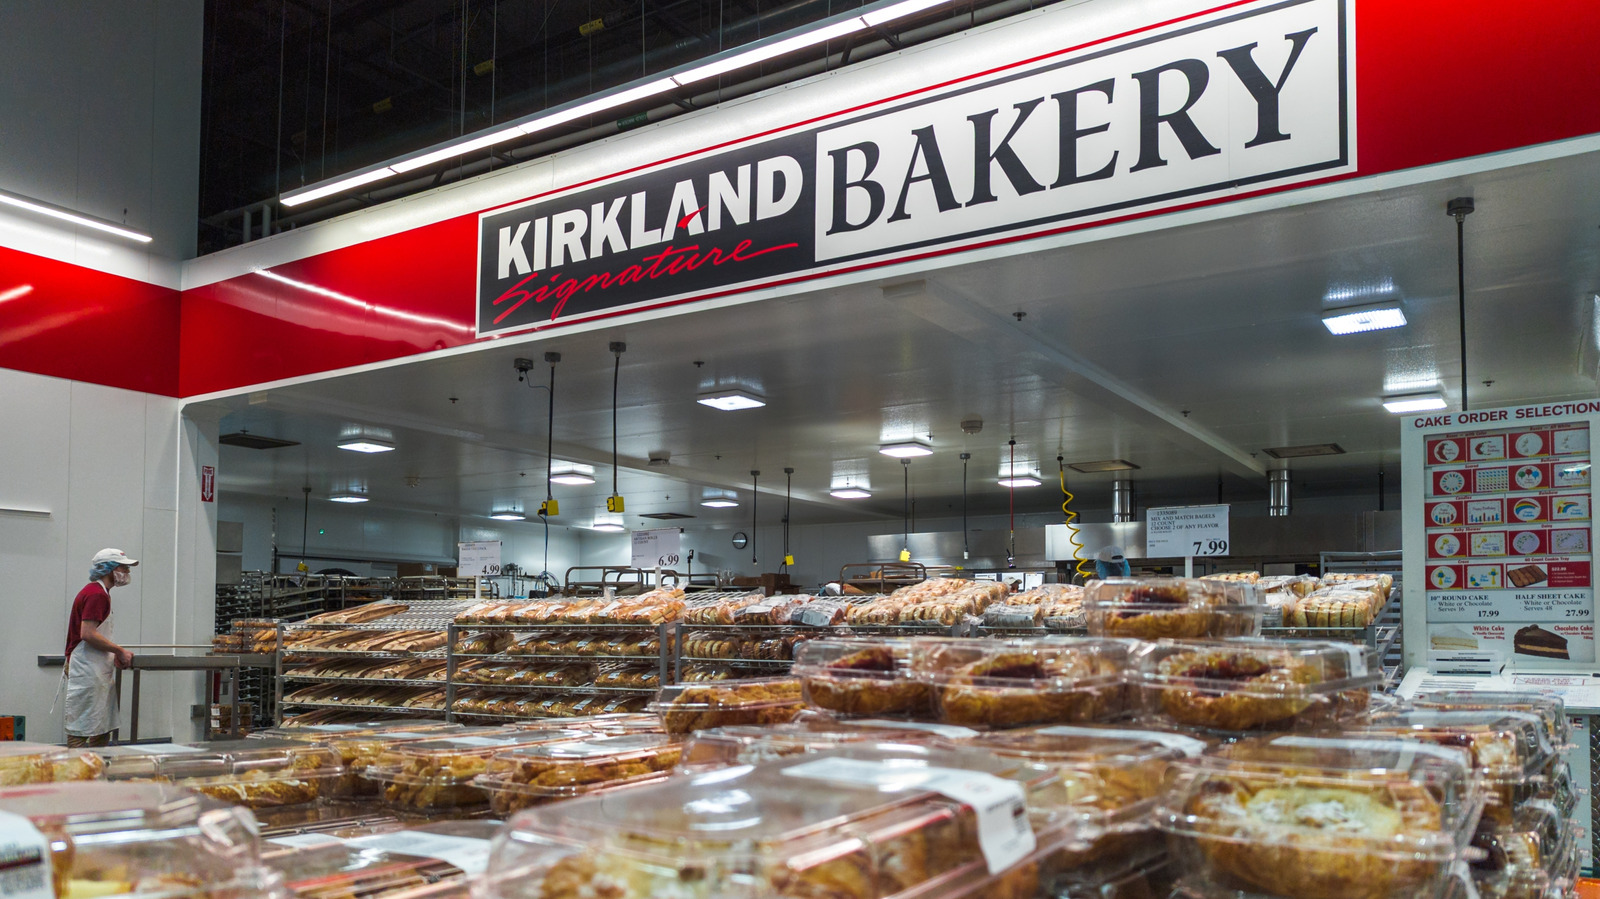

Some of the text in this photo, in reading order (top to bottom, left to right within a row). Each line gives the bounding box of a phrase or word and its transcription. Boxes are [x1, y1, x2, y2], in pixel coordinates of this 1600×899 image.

[826, 26, 1318, 236] BAKERY
[498, 155, 804, 280] KIRKLAND
[492, 238, 798, 324] Signature
[1414, 416, 1452, 428] CAKE
[1458, 410, 1508, 424] ORDER
[1193, 540, 1227, 555] 7.99
[658, 554, 679, 566] 6.99
[482, 565, 500, 574] 4.99
